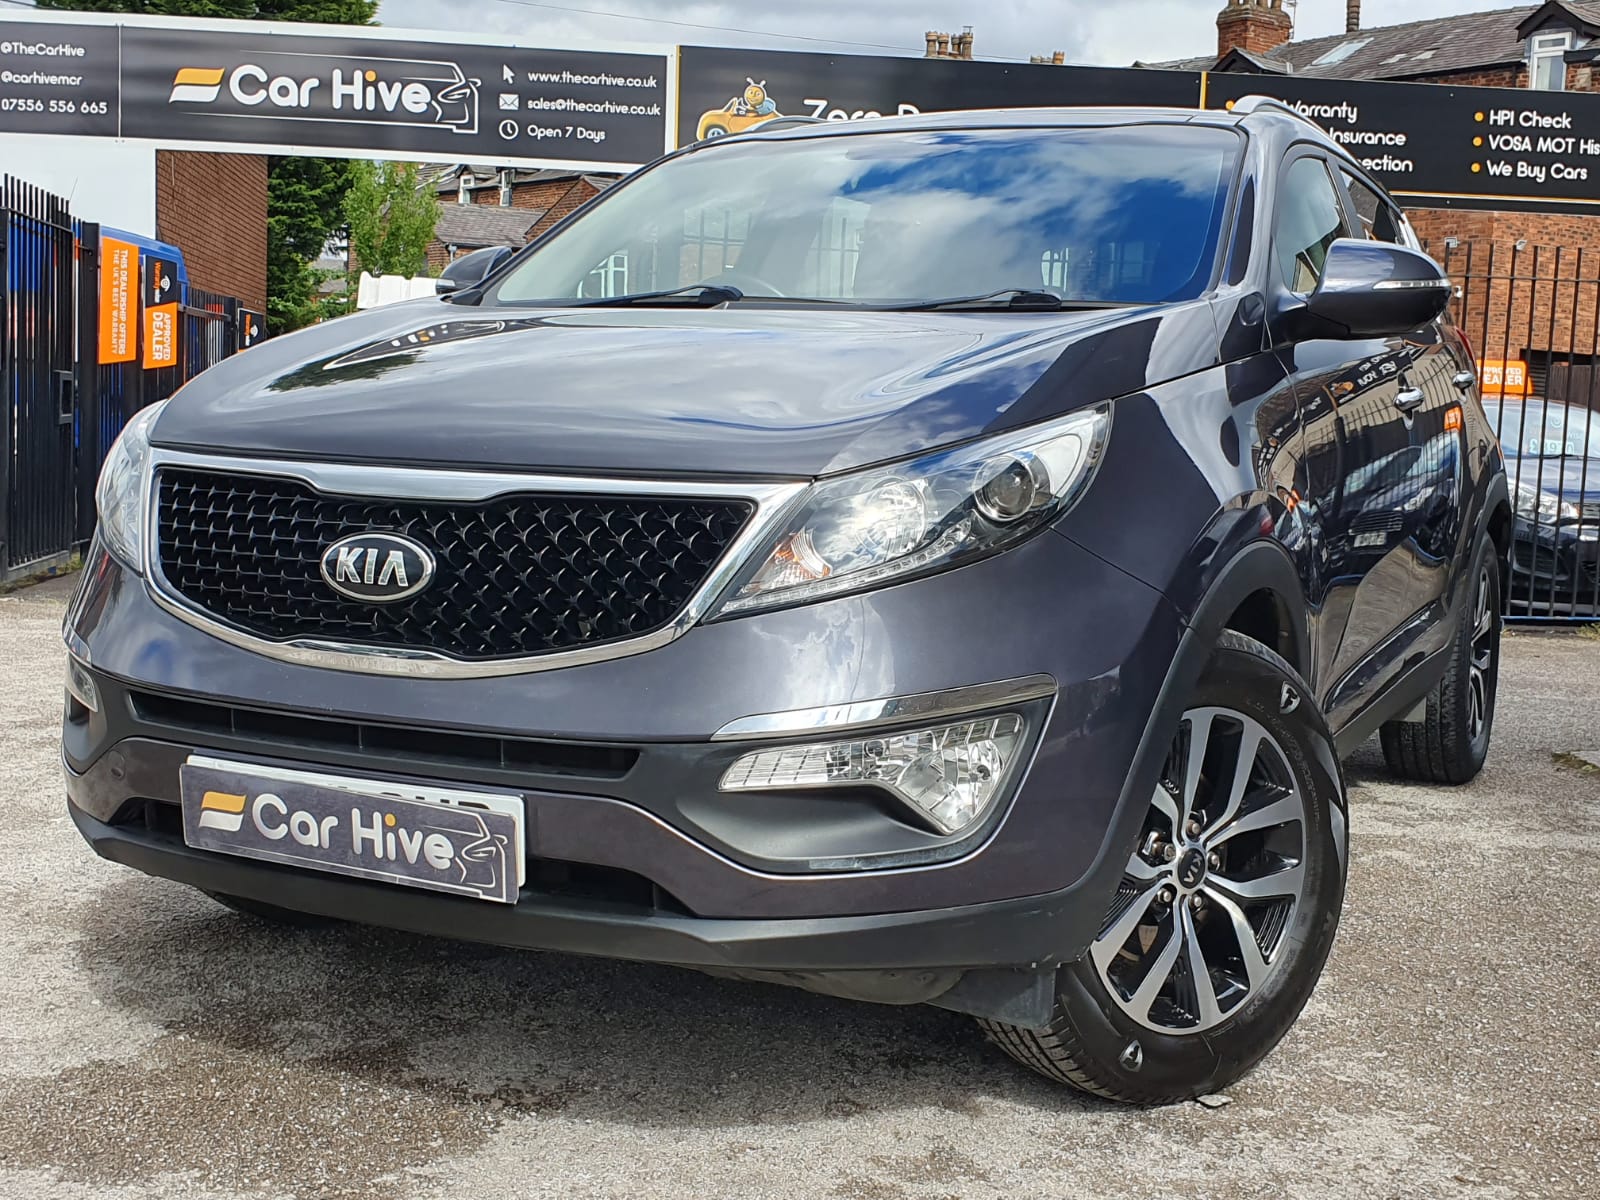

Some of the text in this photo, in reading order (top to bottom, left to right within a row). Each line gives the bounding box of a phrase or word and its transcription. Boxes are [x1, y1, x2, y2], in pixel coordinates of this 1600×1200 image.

[1, 41, 85, 57] @TheCarHive
[1, 71, 82, 87] @carhivemcr
[229, 64, 431, 113] Car Hive
[527, 71, 657, 88] www.thecarhive.co.uk
[1, 98, 107, 115] 07556 556 665
[527, 97, 661, 115] sales@thecarhive.co.uk
[1489, 109, 1572, 129] HPI Check
[527, 124, 606, 143] Open 7 Days
[1329, 127, 1406, 146] Insurance
[1488, 134, 1532, 152] VOSA
[1536, 137, 1576, 154] MOT
[1357, 154, 1413, 172] ection
[1486, 160, 1588, 183] We Buy Cars
[118, 249, 129, 355] THIS DEALERSHIP OFFERS
[152, 311, 164, 360] DEALER
[163, 312, 171, 360] APPROVED
[336, 546, 409, 588] KIA
[252, 793, 455, 870] Car Hive
[1183, 853, 1203, 883] KIA
